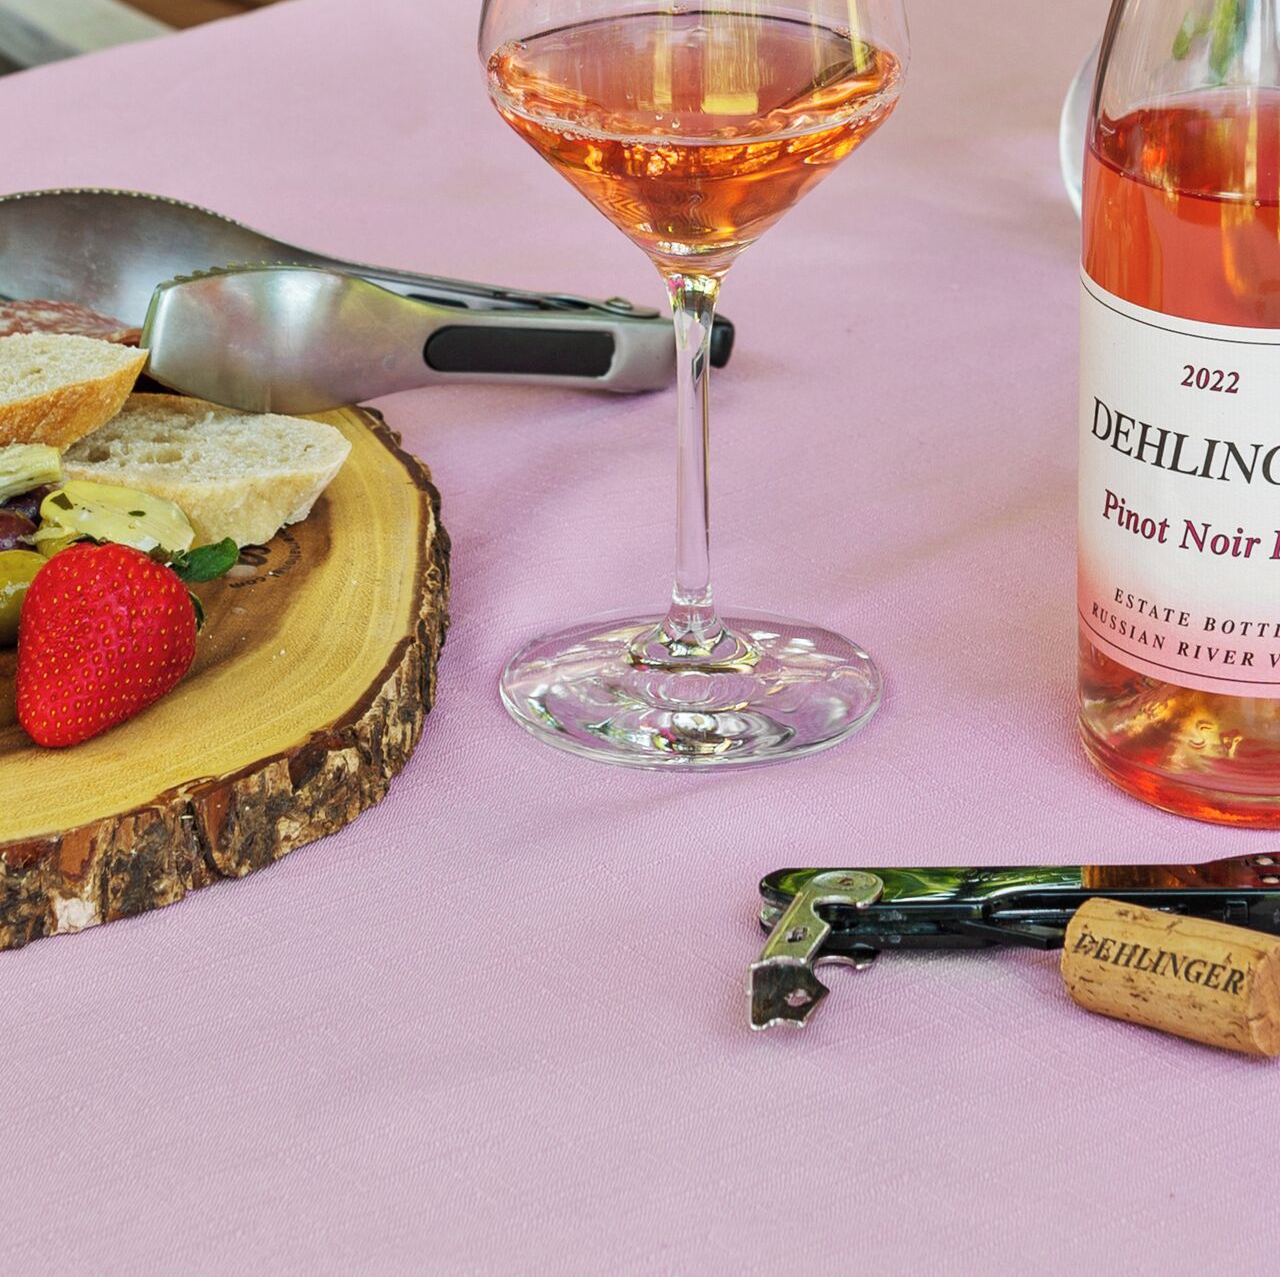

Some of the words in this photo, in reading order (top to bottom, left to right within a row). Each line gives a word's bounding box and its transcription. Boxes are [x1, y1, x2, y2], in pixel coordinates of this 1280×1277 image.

[1181, 364, 1240, 394] 2022
[1102, 489, 1170, 544] Pinot
[1179, 519, 1261, 559] Noir
[1091, 601, 1165, 650] RUSSIAN
[1177, 641, 1255, 667] RIVER
[1114, 588, 1191, 627] ESTATE
[1072, 931, 1246, 996] DEHLINGER
